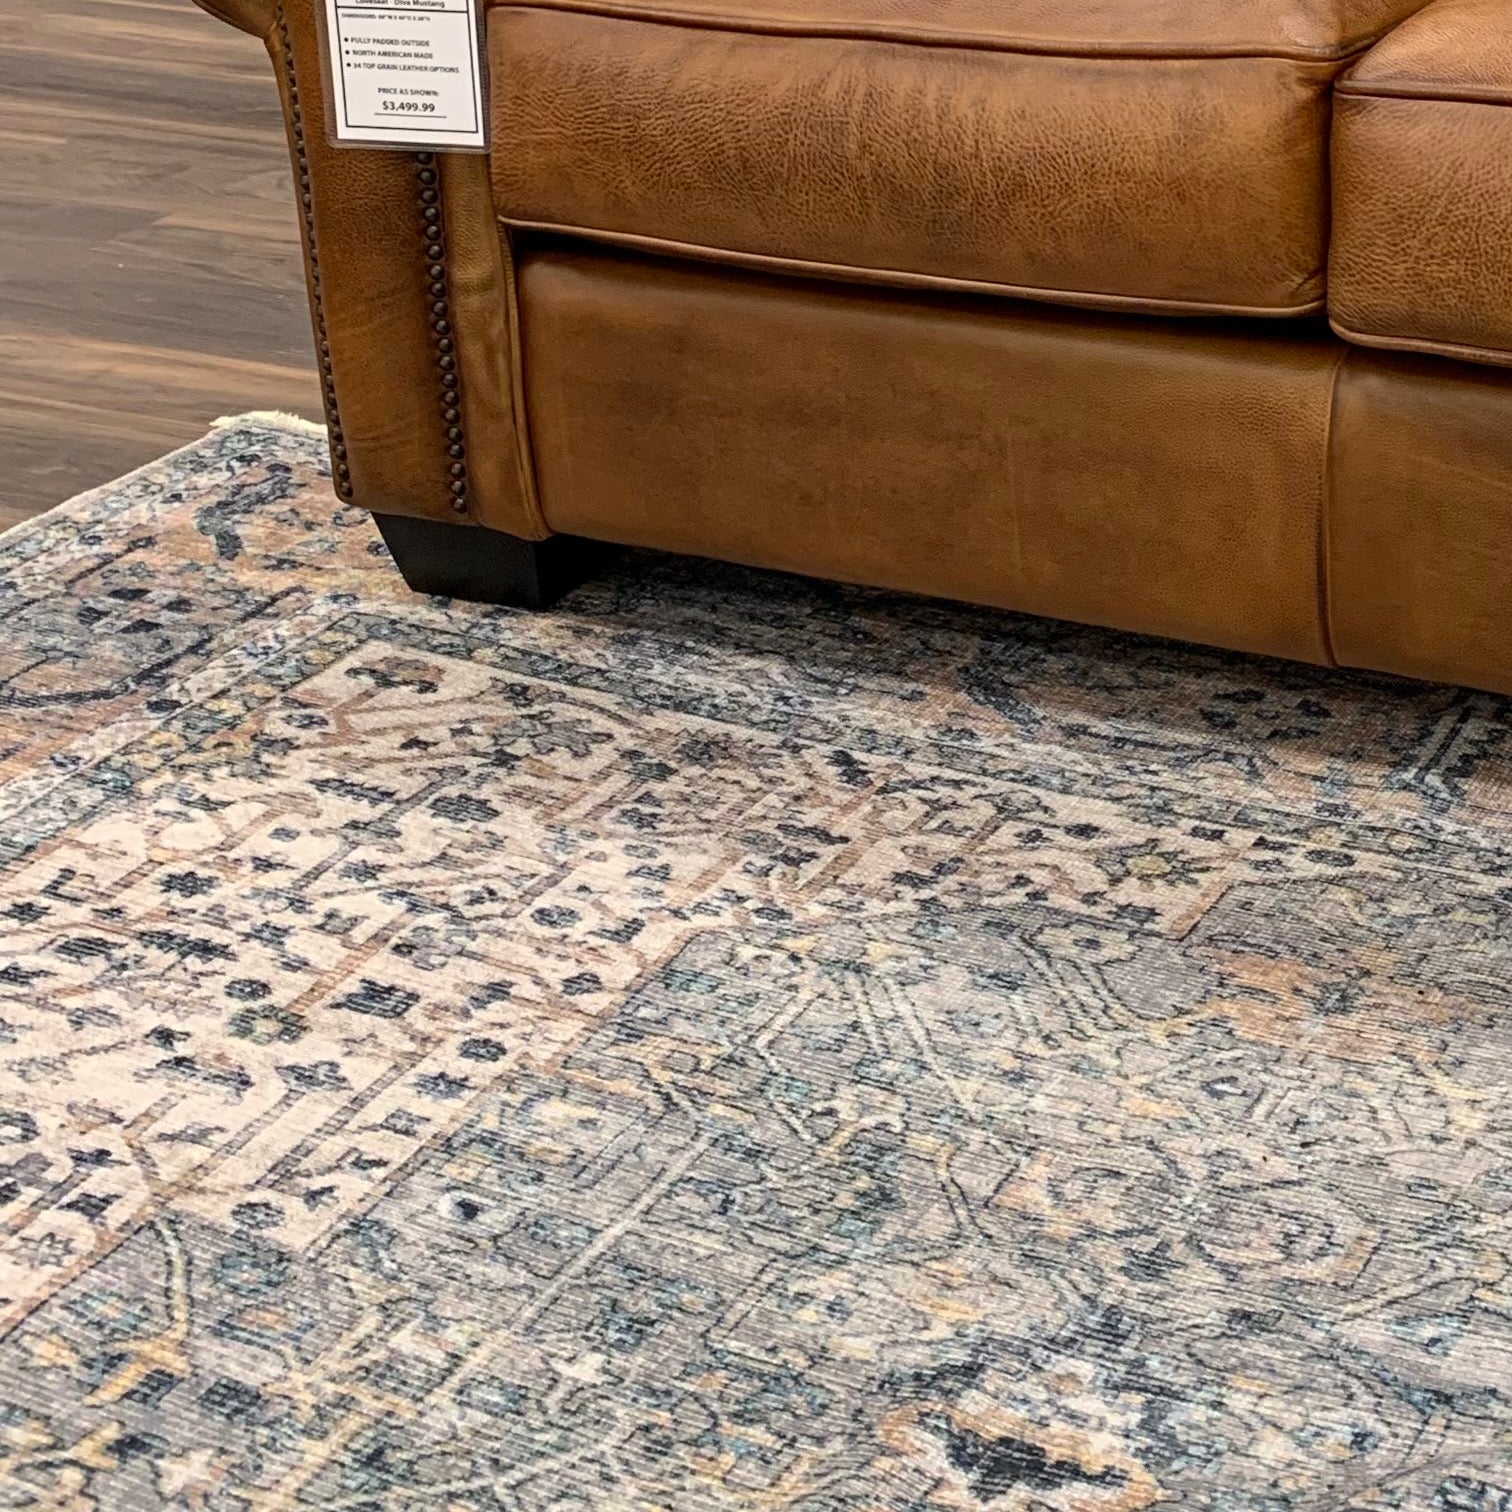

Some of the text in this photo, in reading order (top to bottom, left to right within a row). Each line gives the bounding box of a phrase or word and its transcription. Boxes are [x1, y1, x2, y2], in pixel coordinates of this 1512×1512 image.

[412, 0, 446, 9] Mustang
[400, 39, 430, 47] OUTSIDE
[376, 63, 398, 71] GRAIN
[399, 64, 428, 72] LEATHER
[428, 66, 460, 74] OPTIONS
[382, 100, 435, 113] $3,499.99
